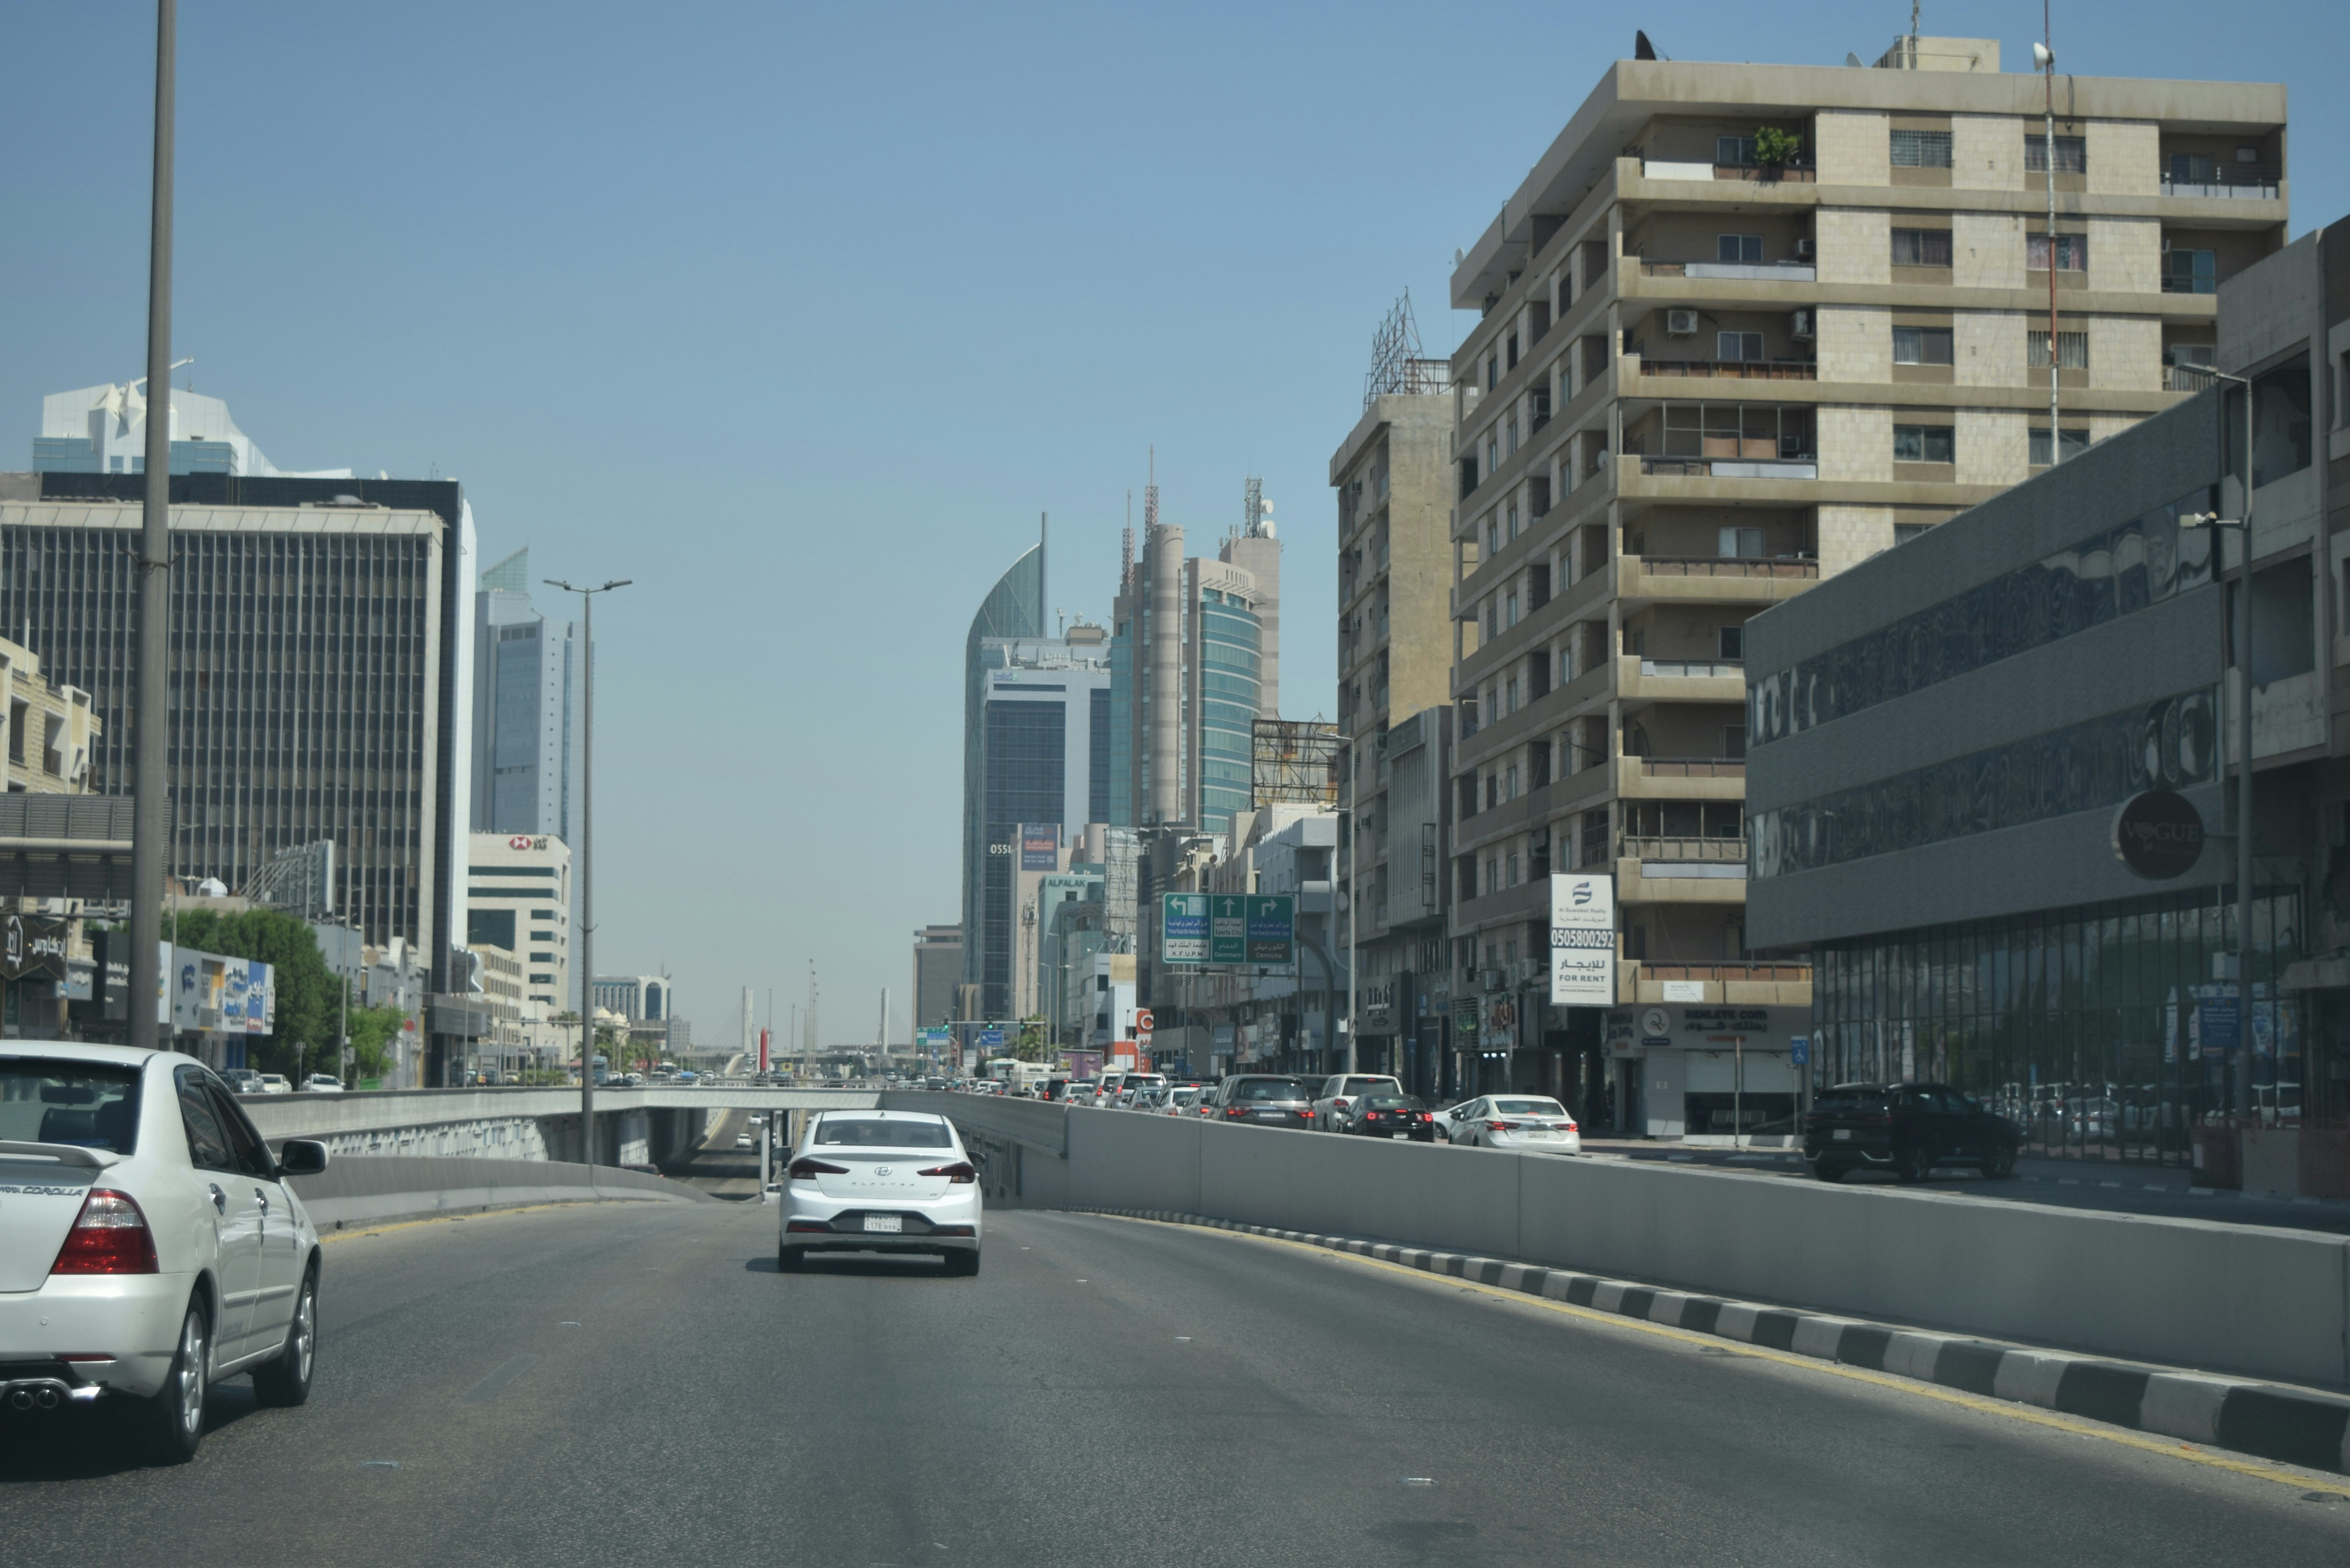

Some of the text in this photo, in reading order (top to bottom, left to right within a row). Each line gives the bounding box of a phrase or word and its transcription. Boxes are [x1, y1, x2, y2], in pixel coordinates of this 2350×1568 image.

[2123, 821, 2200, 841] VOGUE
[1047, 879, 1086, 887] ALFALAK
[1551, 928, 1614, 948] 0505800292
[1218, 942, 1238, 951] الدمام
[1254, 943, 1285, 951] الكورنيش
[22, 1185, 85, 1196] COROLLA
